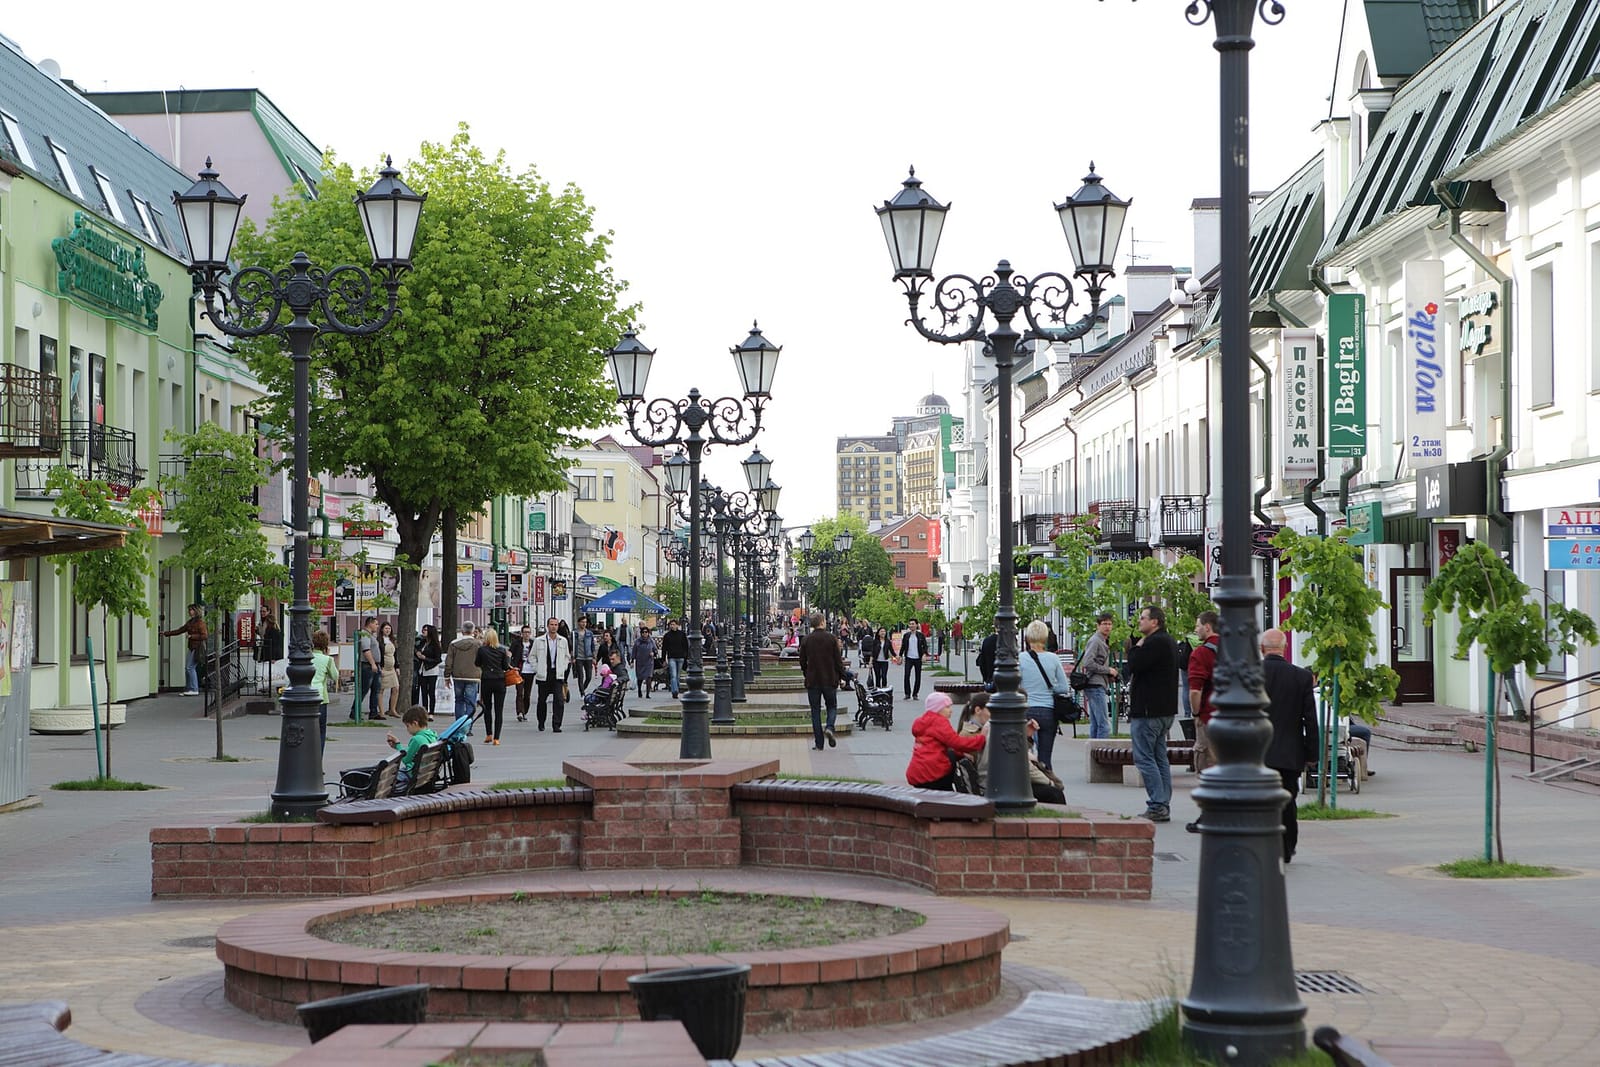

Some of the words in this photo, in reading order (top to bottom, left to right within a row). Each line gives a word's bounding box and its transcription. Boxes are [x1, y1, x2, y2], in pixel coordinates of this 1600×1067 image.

[1334, 335, 1360, 417] Bagira
[1292, 346, 1310, 448] ПАССАЖ
[1353, 448, 1361, 456] 31
[1412, 435, 1420, 447] 2
[1421, 439, 1441, 447] этаж
[1423, 447, 1442, 457] №30
[1425, 475, 1441, 510] Lee
